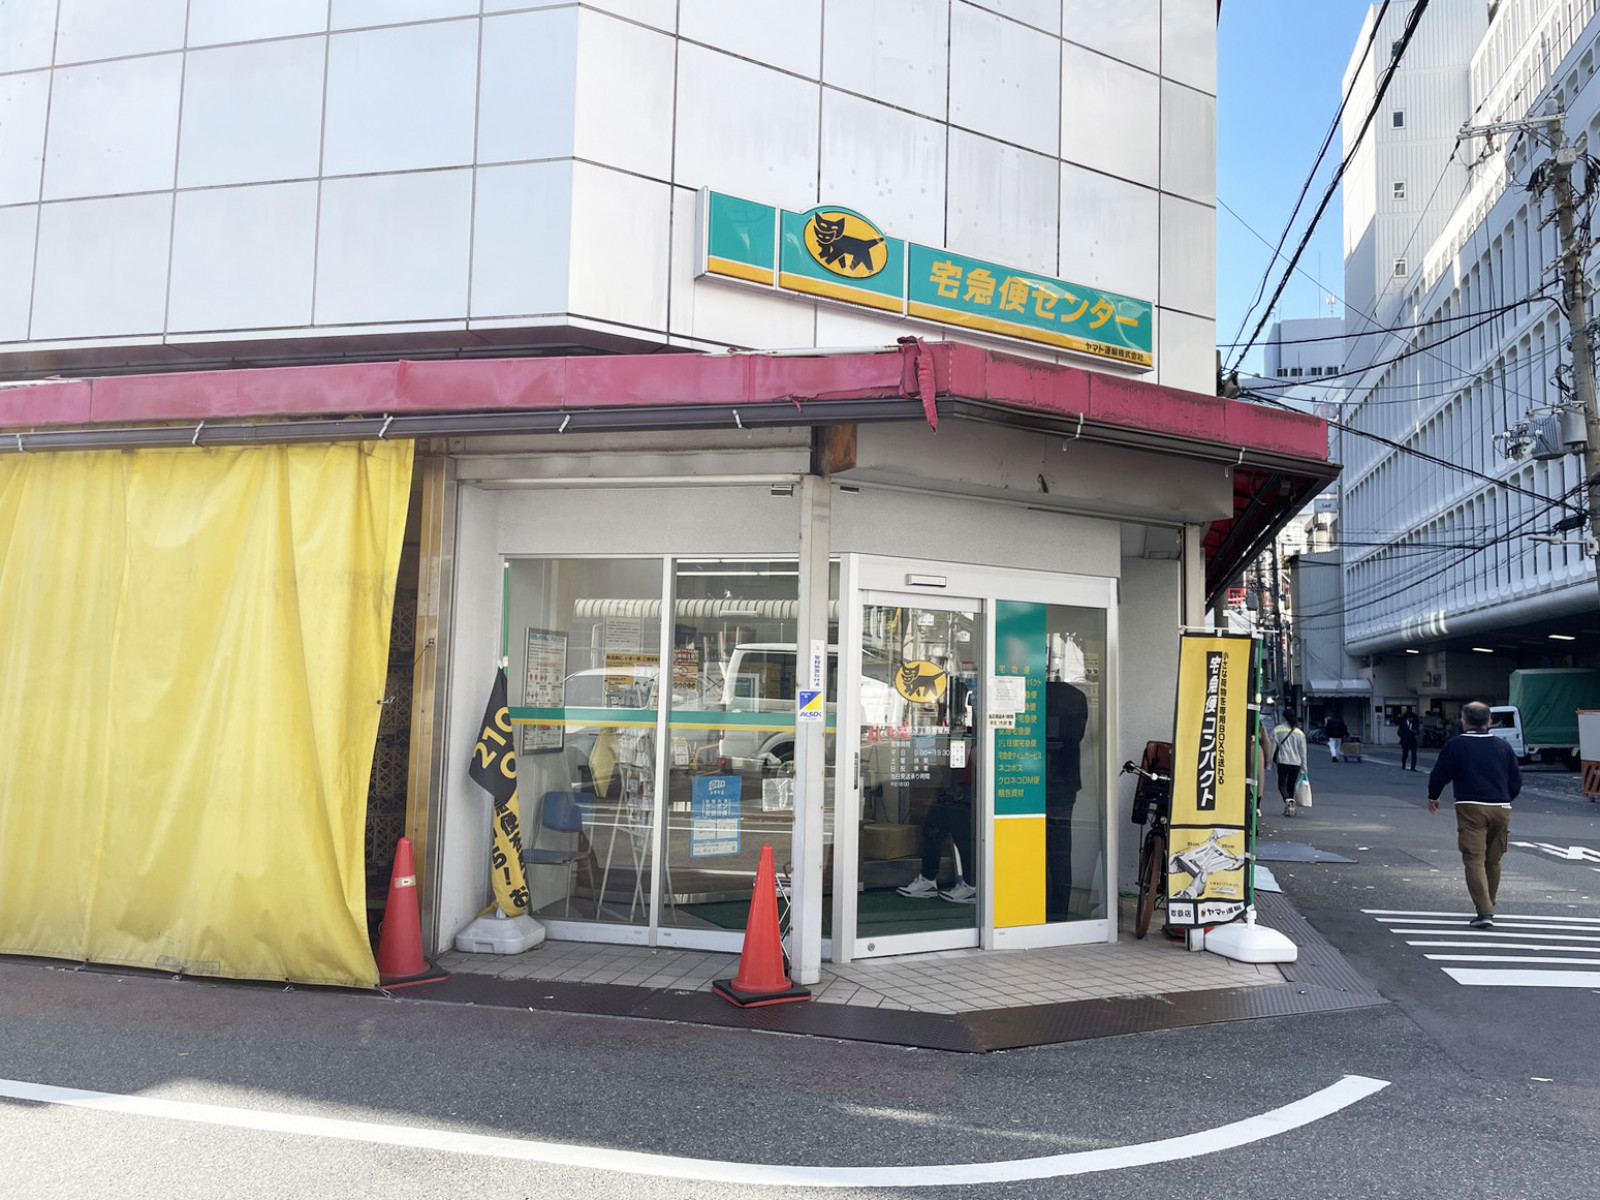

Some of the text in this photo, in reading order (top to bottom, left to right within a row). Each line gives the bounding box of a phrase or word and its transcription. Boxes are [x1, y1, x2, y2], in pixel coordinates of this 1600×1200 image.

[929, 260, 1138, 329] 宅急便センター
[1085, 341, 1144, 361] ヤマト運輸株式会社
[1198, 655, 1221, 807] 宅急便コンパクト
[998, 776, 1040, 785] クロネコDM便
